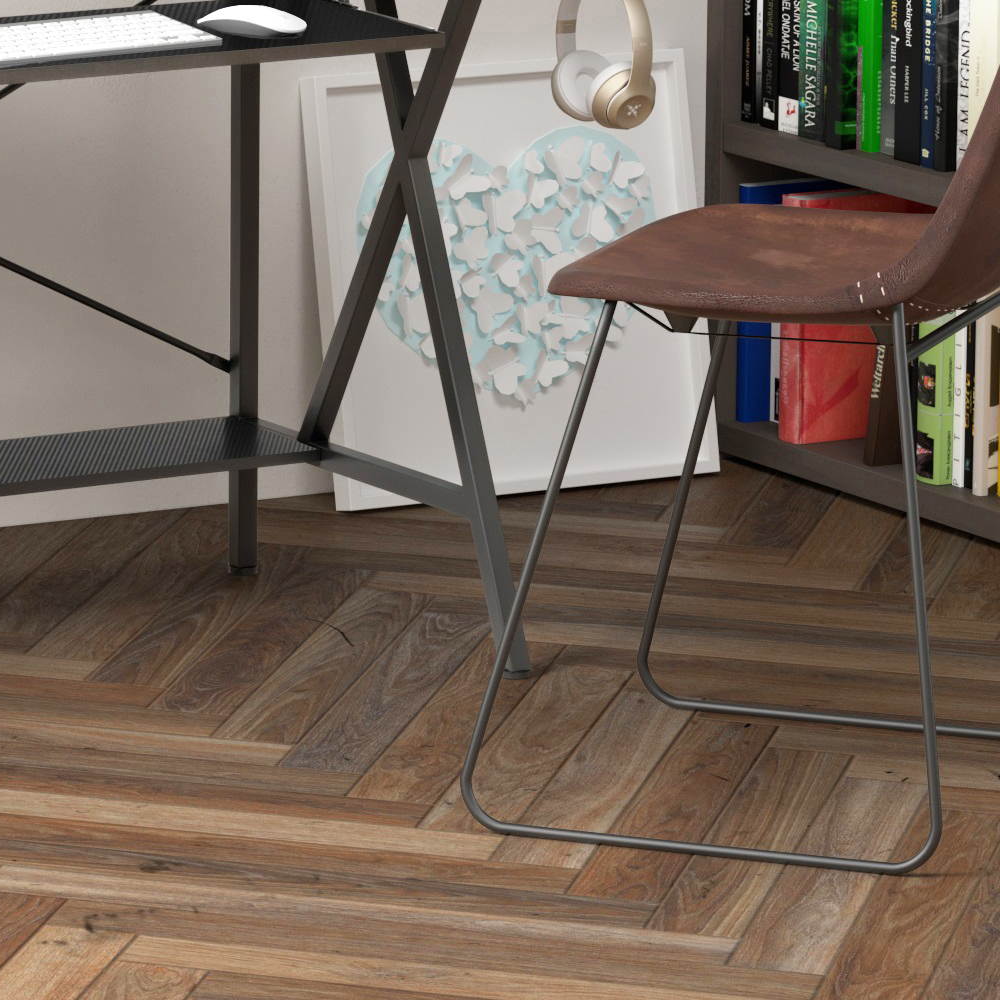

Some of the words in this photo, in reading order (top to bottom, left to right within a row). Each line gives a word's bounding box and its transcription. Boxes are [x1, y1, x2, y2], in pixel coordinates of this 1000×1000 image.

[793, 0, 801, 22] SKIN
[793, 24, 801, 37] OF
[781, 13, 791, 60] ONDAATJE
[792, 39, 801, 47] A
[804, 0, 818, 72] MICHELLE
[924, 19, 932, 62] BRIDGE
[792, 48, 801, 72] LION
[803, 74, 817, 128] SAGARA
[870, 344, 886, 399] Weltarch
